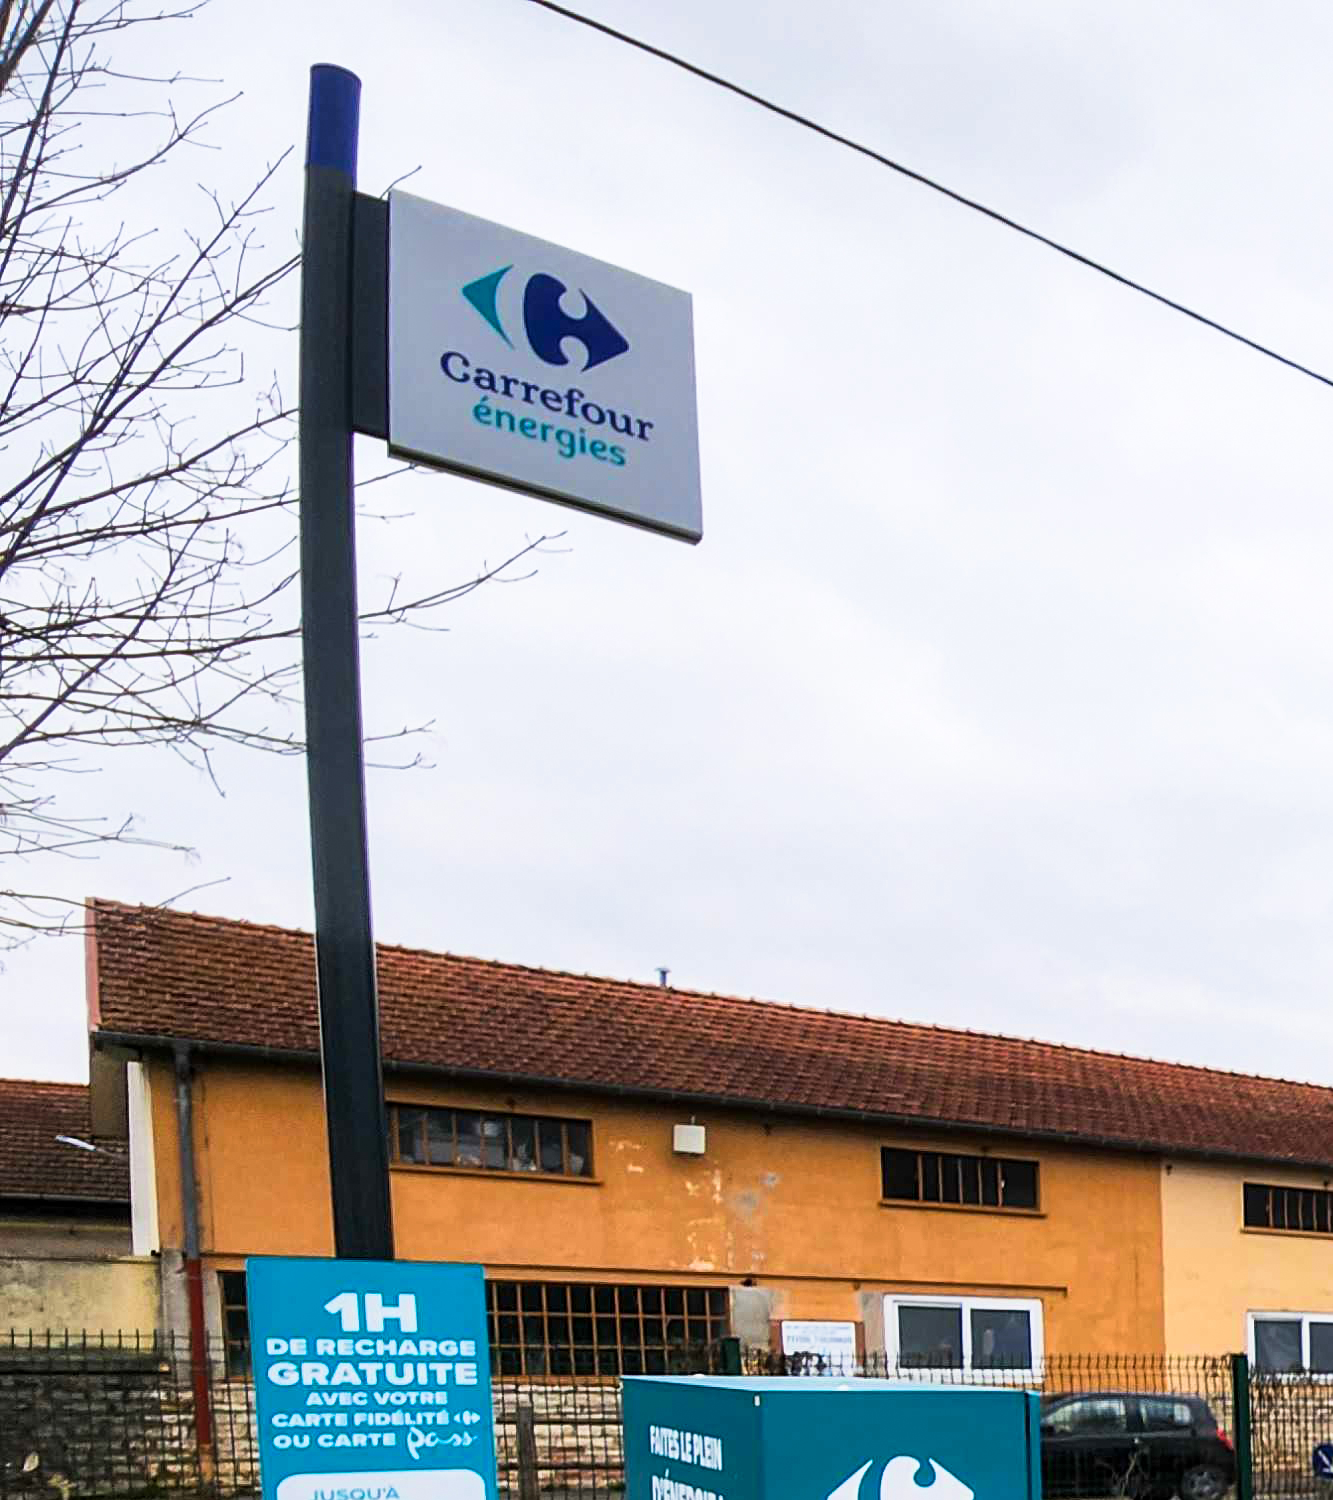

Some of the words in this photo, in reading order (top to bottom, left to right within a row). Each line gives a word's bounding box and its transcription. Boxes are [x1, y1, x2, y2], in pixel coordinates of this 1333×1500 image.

[440, 351, 654, 441] Carrefour
[472, 395, 627, 466] énergies
[324, 1292, 418, 1333] 1H
[266, 1338, 307, 1356] DE
[316, 1338, 477, 1357] RECHARGE
[267, 1362, 478, 1386] GRATUITE
[306, 1391, 368, 1406] AVEC
[374, 1391, 448, 1405] VOTRE
[271, 1412, 348, 1427] CARTE
[353, 1409, 450, 1426] FIDÉLITÉ
[273, 1433, 310, 1448] OU
[317, 1432, 396, 1448] CARTE
[680, 1431, 693, 1463] LE
[693, 1433, 723, 1471] PLEIN
